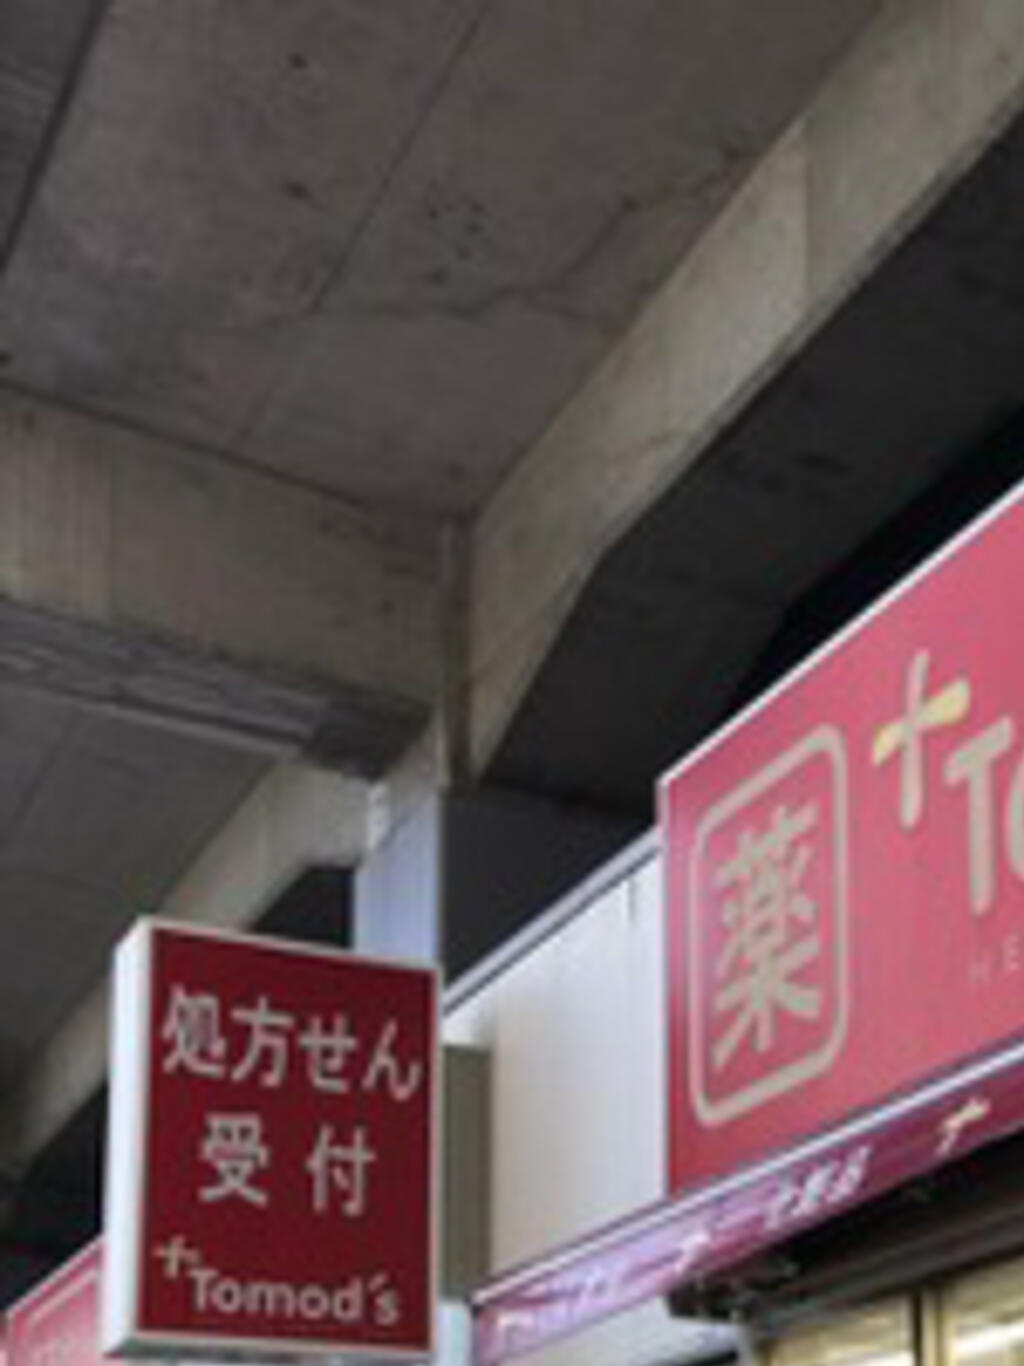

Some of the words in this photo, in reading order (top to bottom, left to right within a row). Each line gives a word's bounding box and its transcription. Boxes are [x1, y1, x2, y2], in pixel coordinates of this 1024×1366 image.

[711, 800, 821, 1070] 薬
[160, 984, 422, 1101] 処方せん
[190, 1267, 399, 1326] Tomod's
